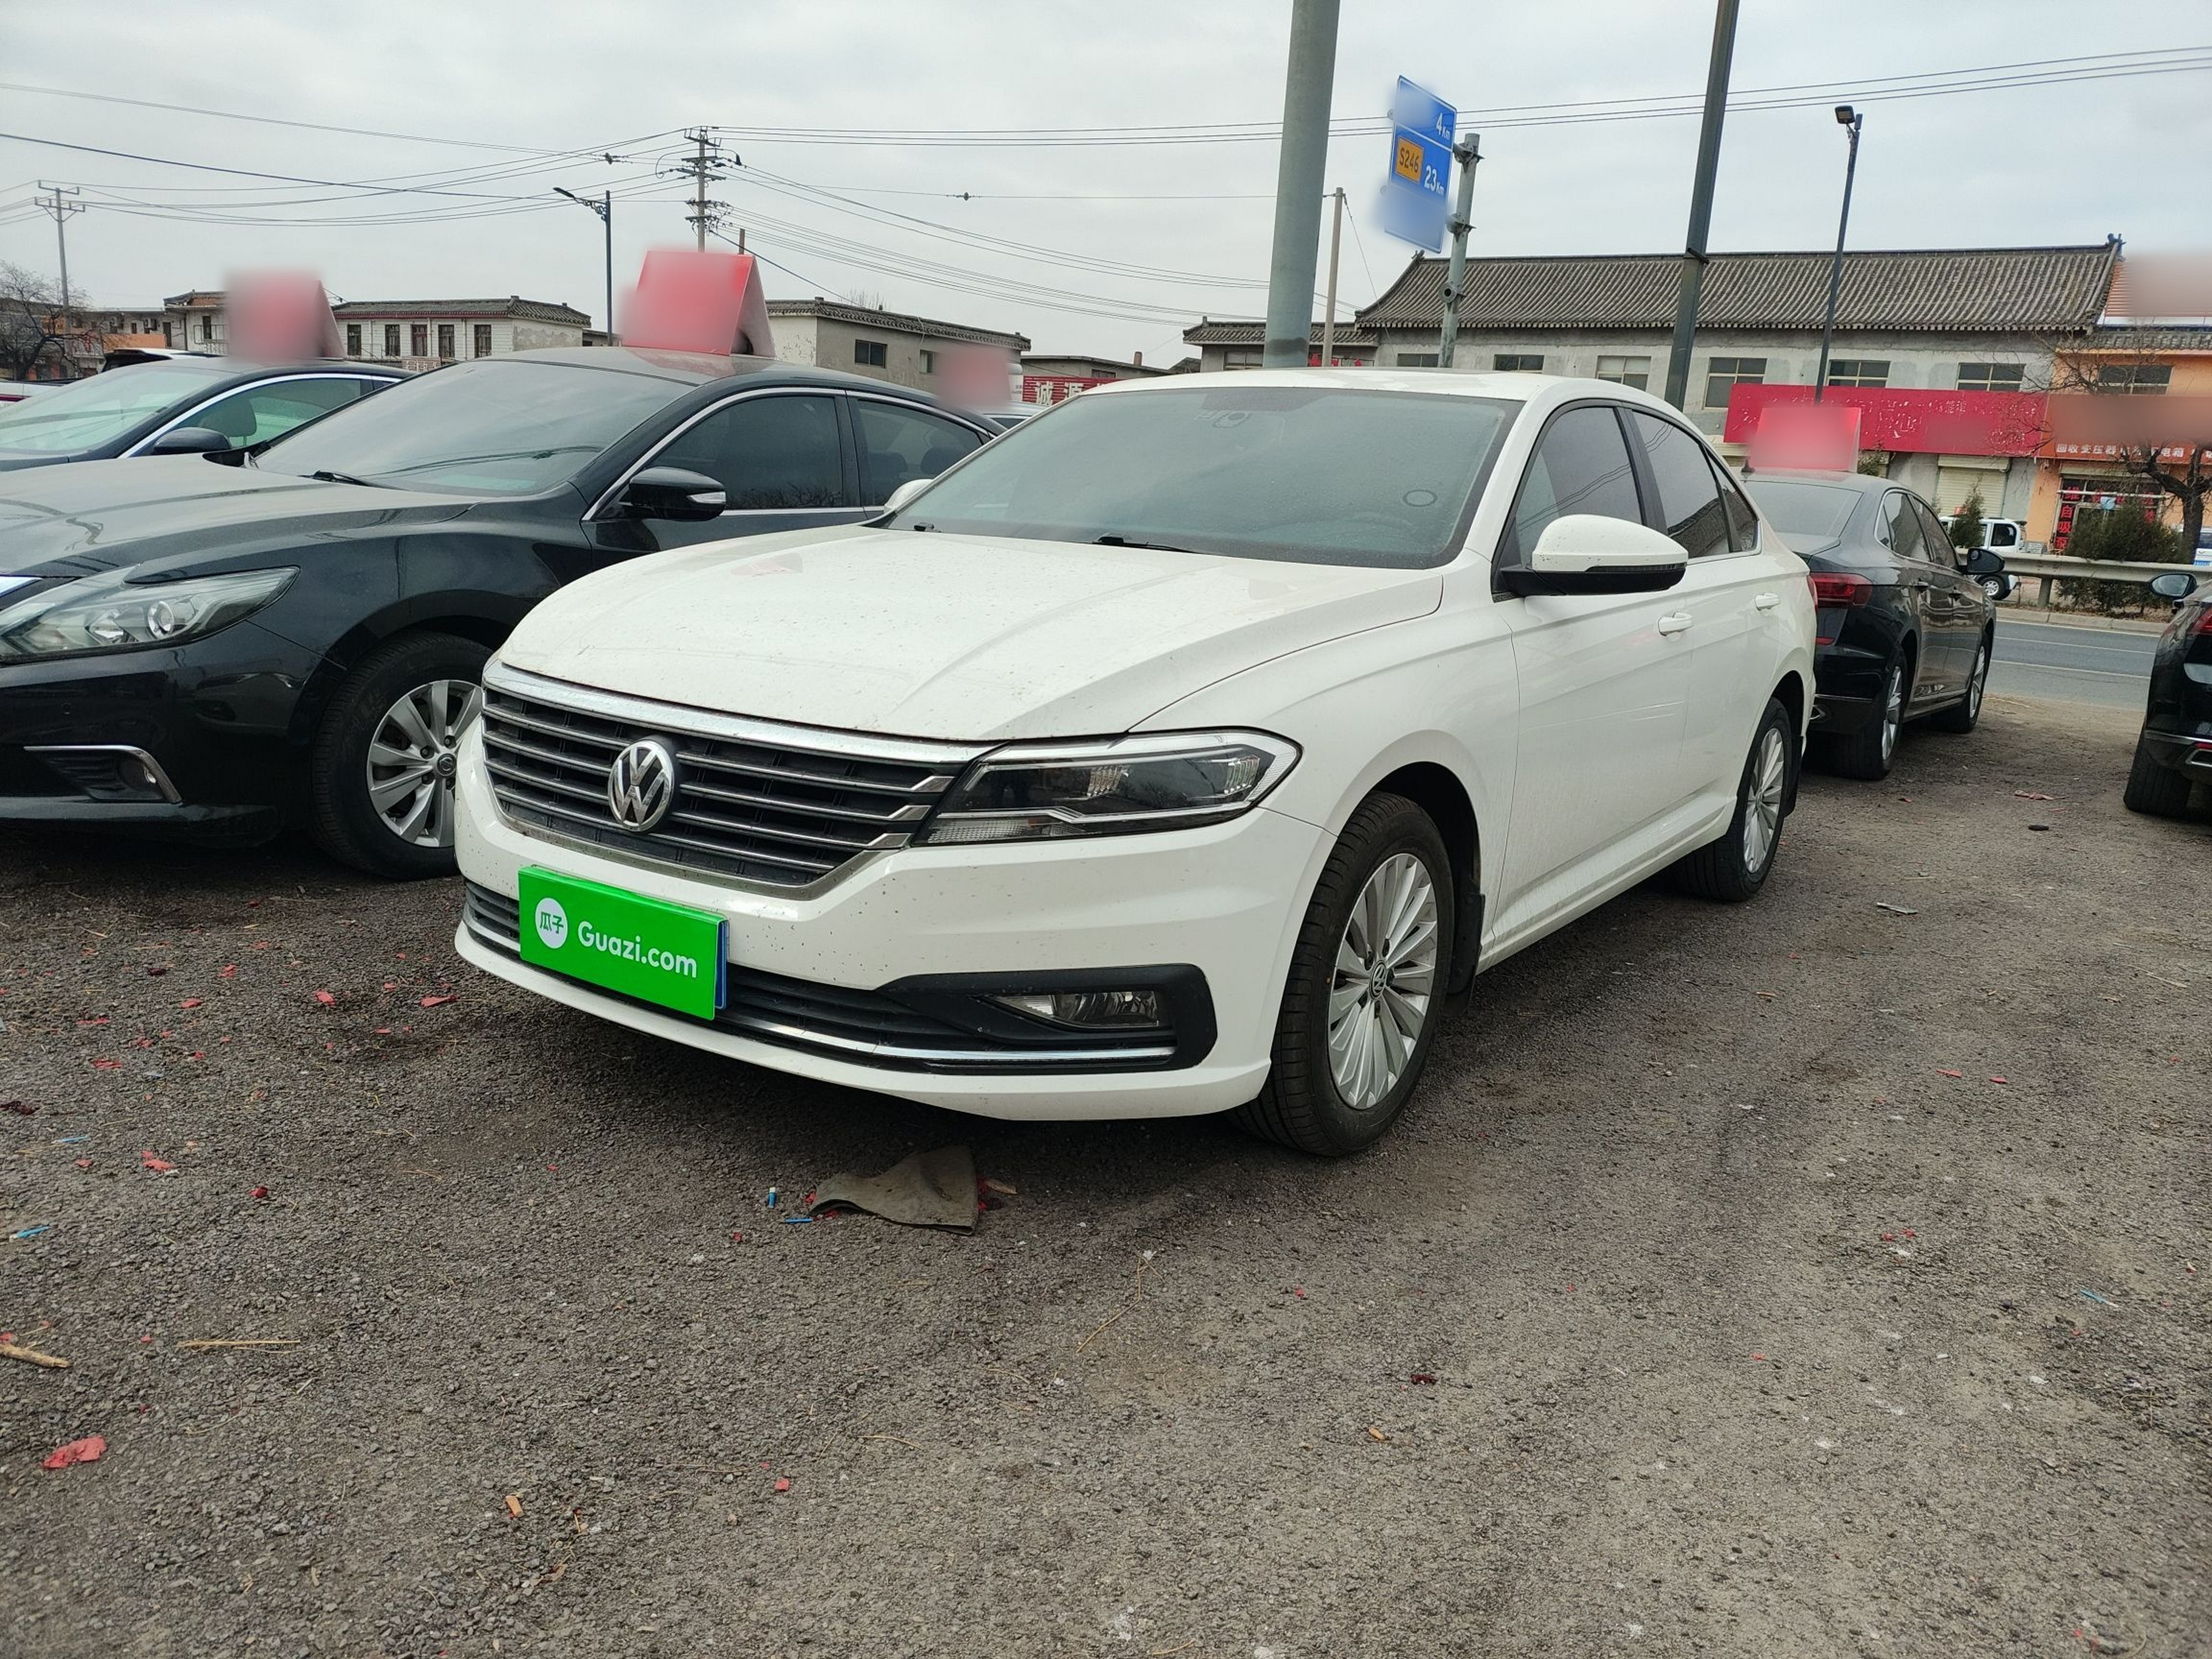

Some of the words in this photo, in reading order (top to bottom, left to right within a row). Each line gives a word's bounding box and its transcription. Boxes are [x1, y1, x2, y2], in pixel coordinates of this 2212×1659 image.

[1399, 147, 1419, 173] S246
[539, 911, 564, 934] 瓜子
[577, 921, 697, 978] Guazi.com
